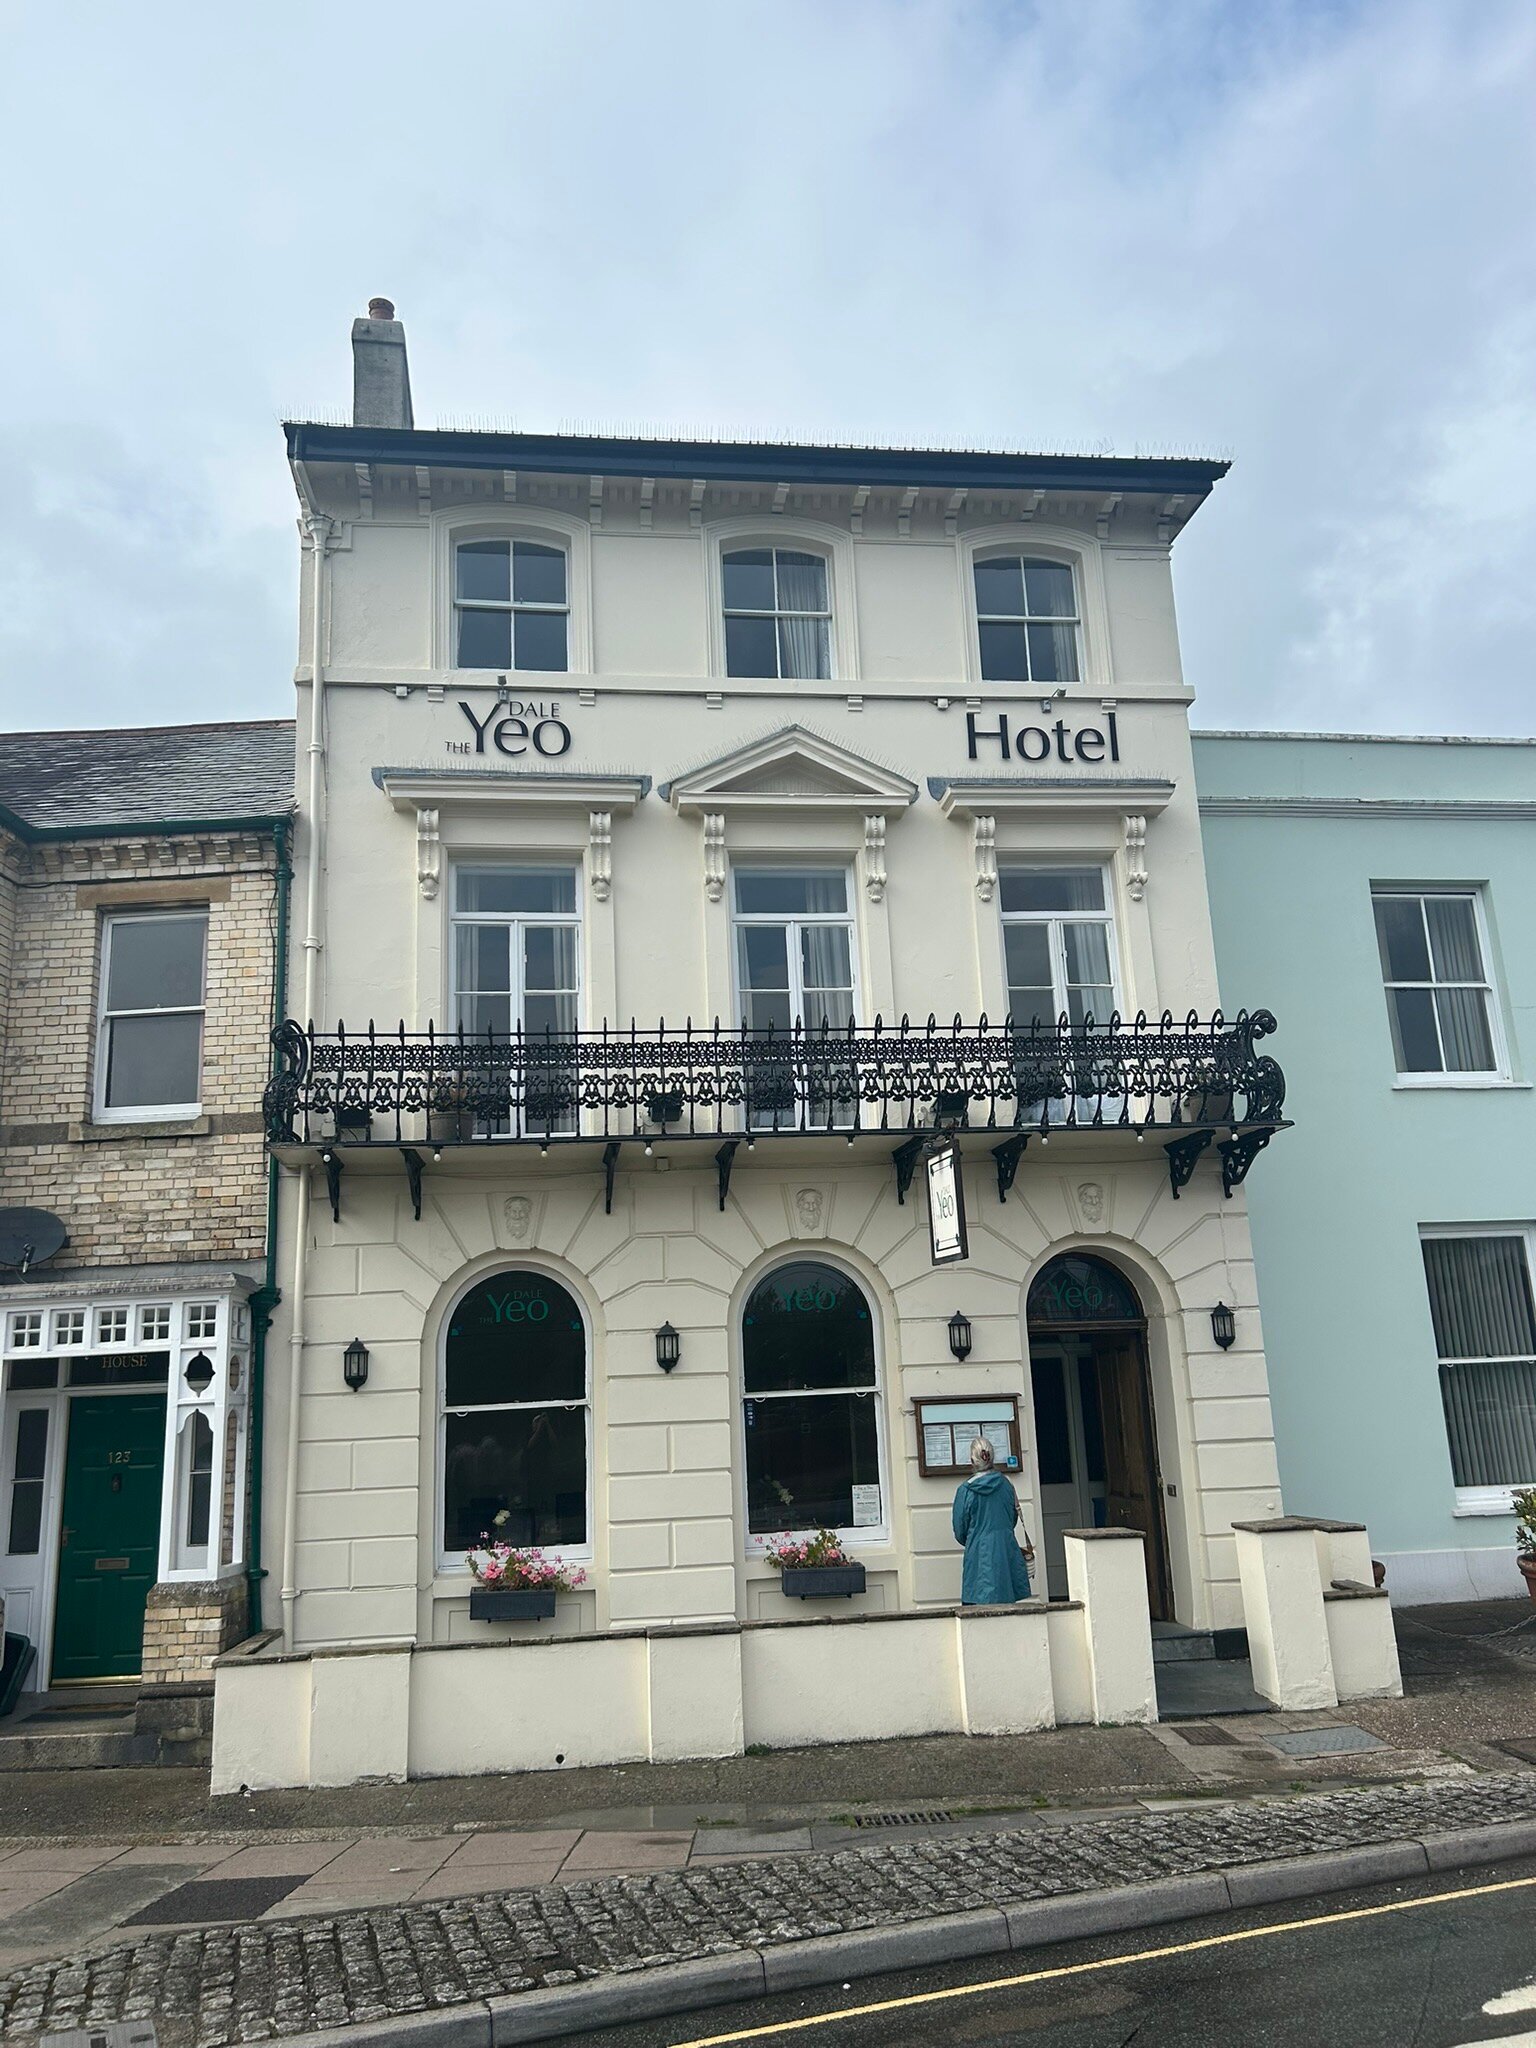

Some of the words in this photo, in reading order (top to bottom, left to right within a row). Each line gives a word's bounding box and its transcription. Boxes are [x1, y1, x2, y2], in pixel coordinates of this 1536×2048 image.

[509, 701, 561, 718] DALE
[457, 701, 572, 756] Yeo
[966, 712, 1120, 762] Hotel
[445, 740, 471, 754] THE
[936, 1197, 954, 1219] Yeo
[514, 1289, 543, 1299] DALE
[775, 1281, 837, 1312] Yeo
[1047, 1279, 1102, 1311] Yeo
[486, 1292, 549, 1323] Yeo
[102, 1355, 147, 1368] HOUSE
[108, 1451, 131, 1463] 123
